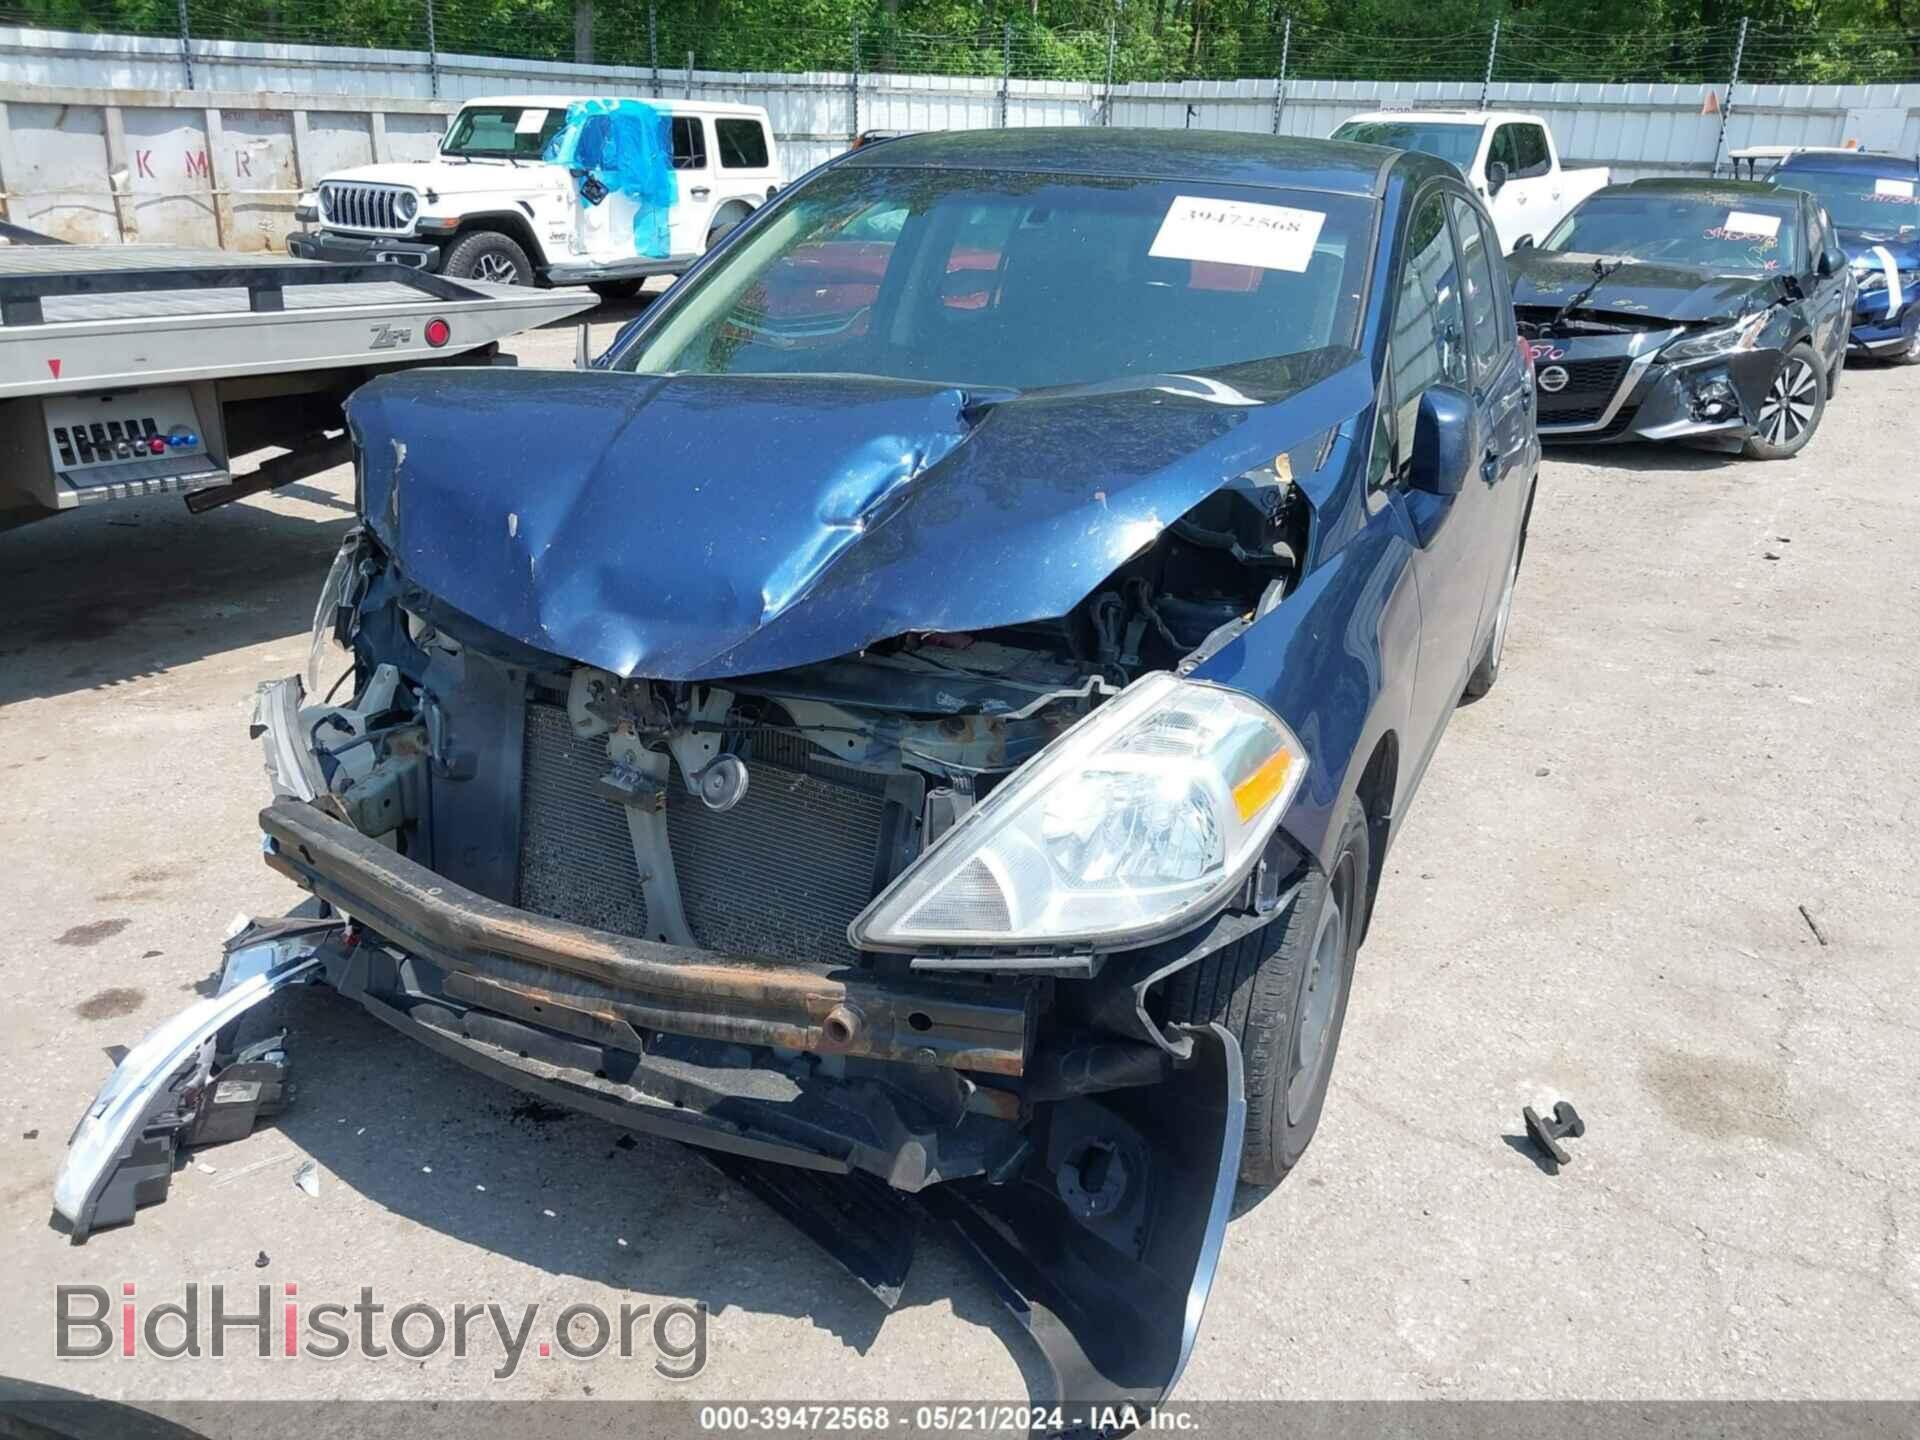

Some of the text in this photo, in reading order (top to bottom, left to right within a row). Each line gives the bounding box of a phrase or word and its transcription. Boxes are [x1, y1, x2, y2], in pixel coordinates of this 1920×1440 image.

[135, 149, 252, 178] K M R
